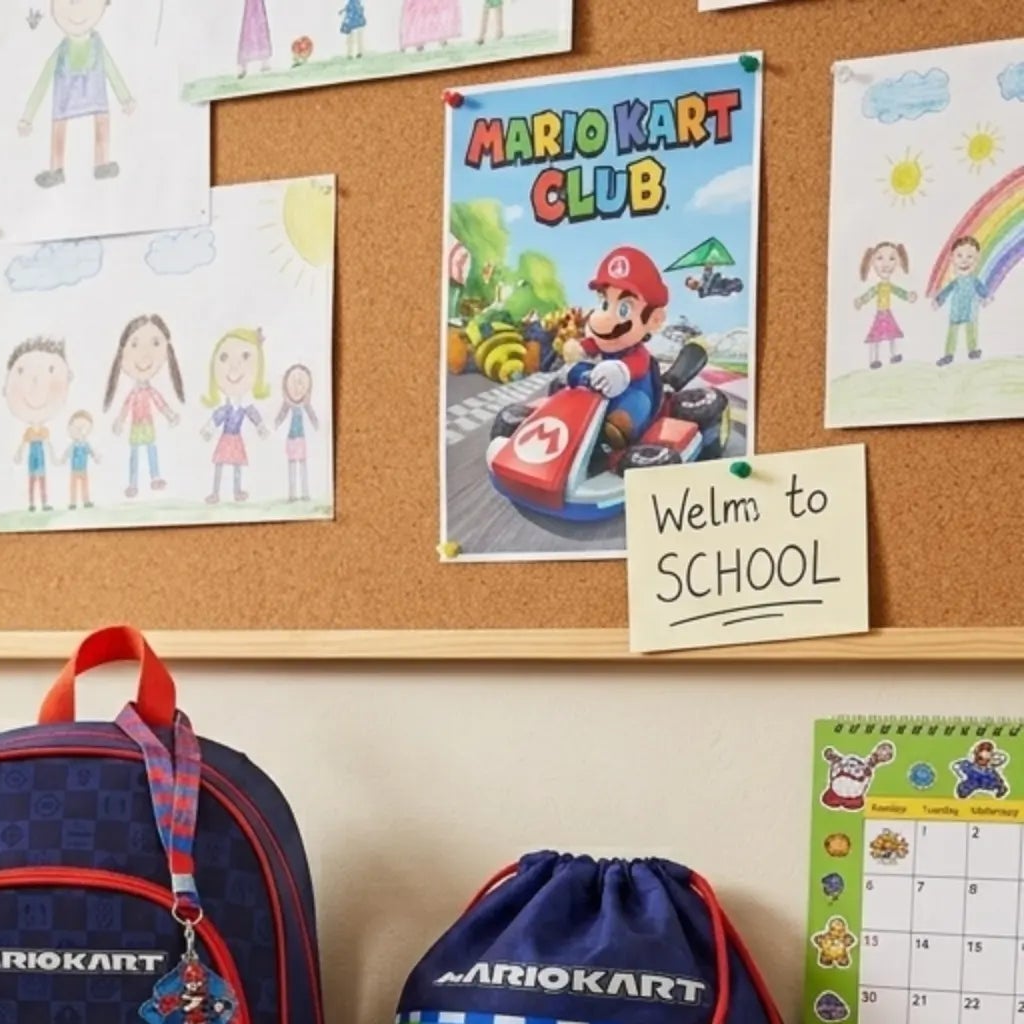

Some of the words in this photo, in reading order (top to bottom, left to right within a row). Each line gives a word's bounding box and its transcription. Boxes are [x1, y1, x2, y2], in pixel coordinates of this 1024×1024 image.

[465, 108, 609, 169] MARIO
[613, 88, 742, 156] KART
[530, 155, 666, 227] CLUB
[784, 473, 829, 519] to
[656, 539, 841, 603] SCHOOL
[971, 826, 980, 839] 2
[917, 881, 925, 892] 7
[968, 883, 978, 895] 8
[915, 938, 930, 950] 14
[967, 941, 983, 953] 15
[861, 991, 877, 1003] 30
[911, 994, 927, 1006] 21
[963, 998, 980, 1010] 22
